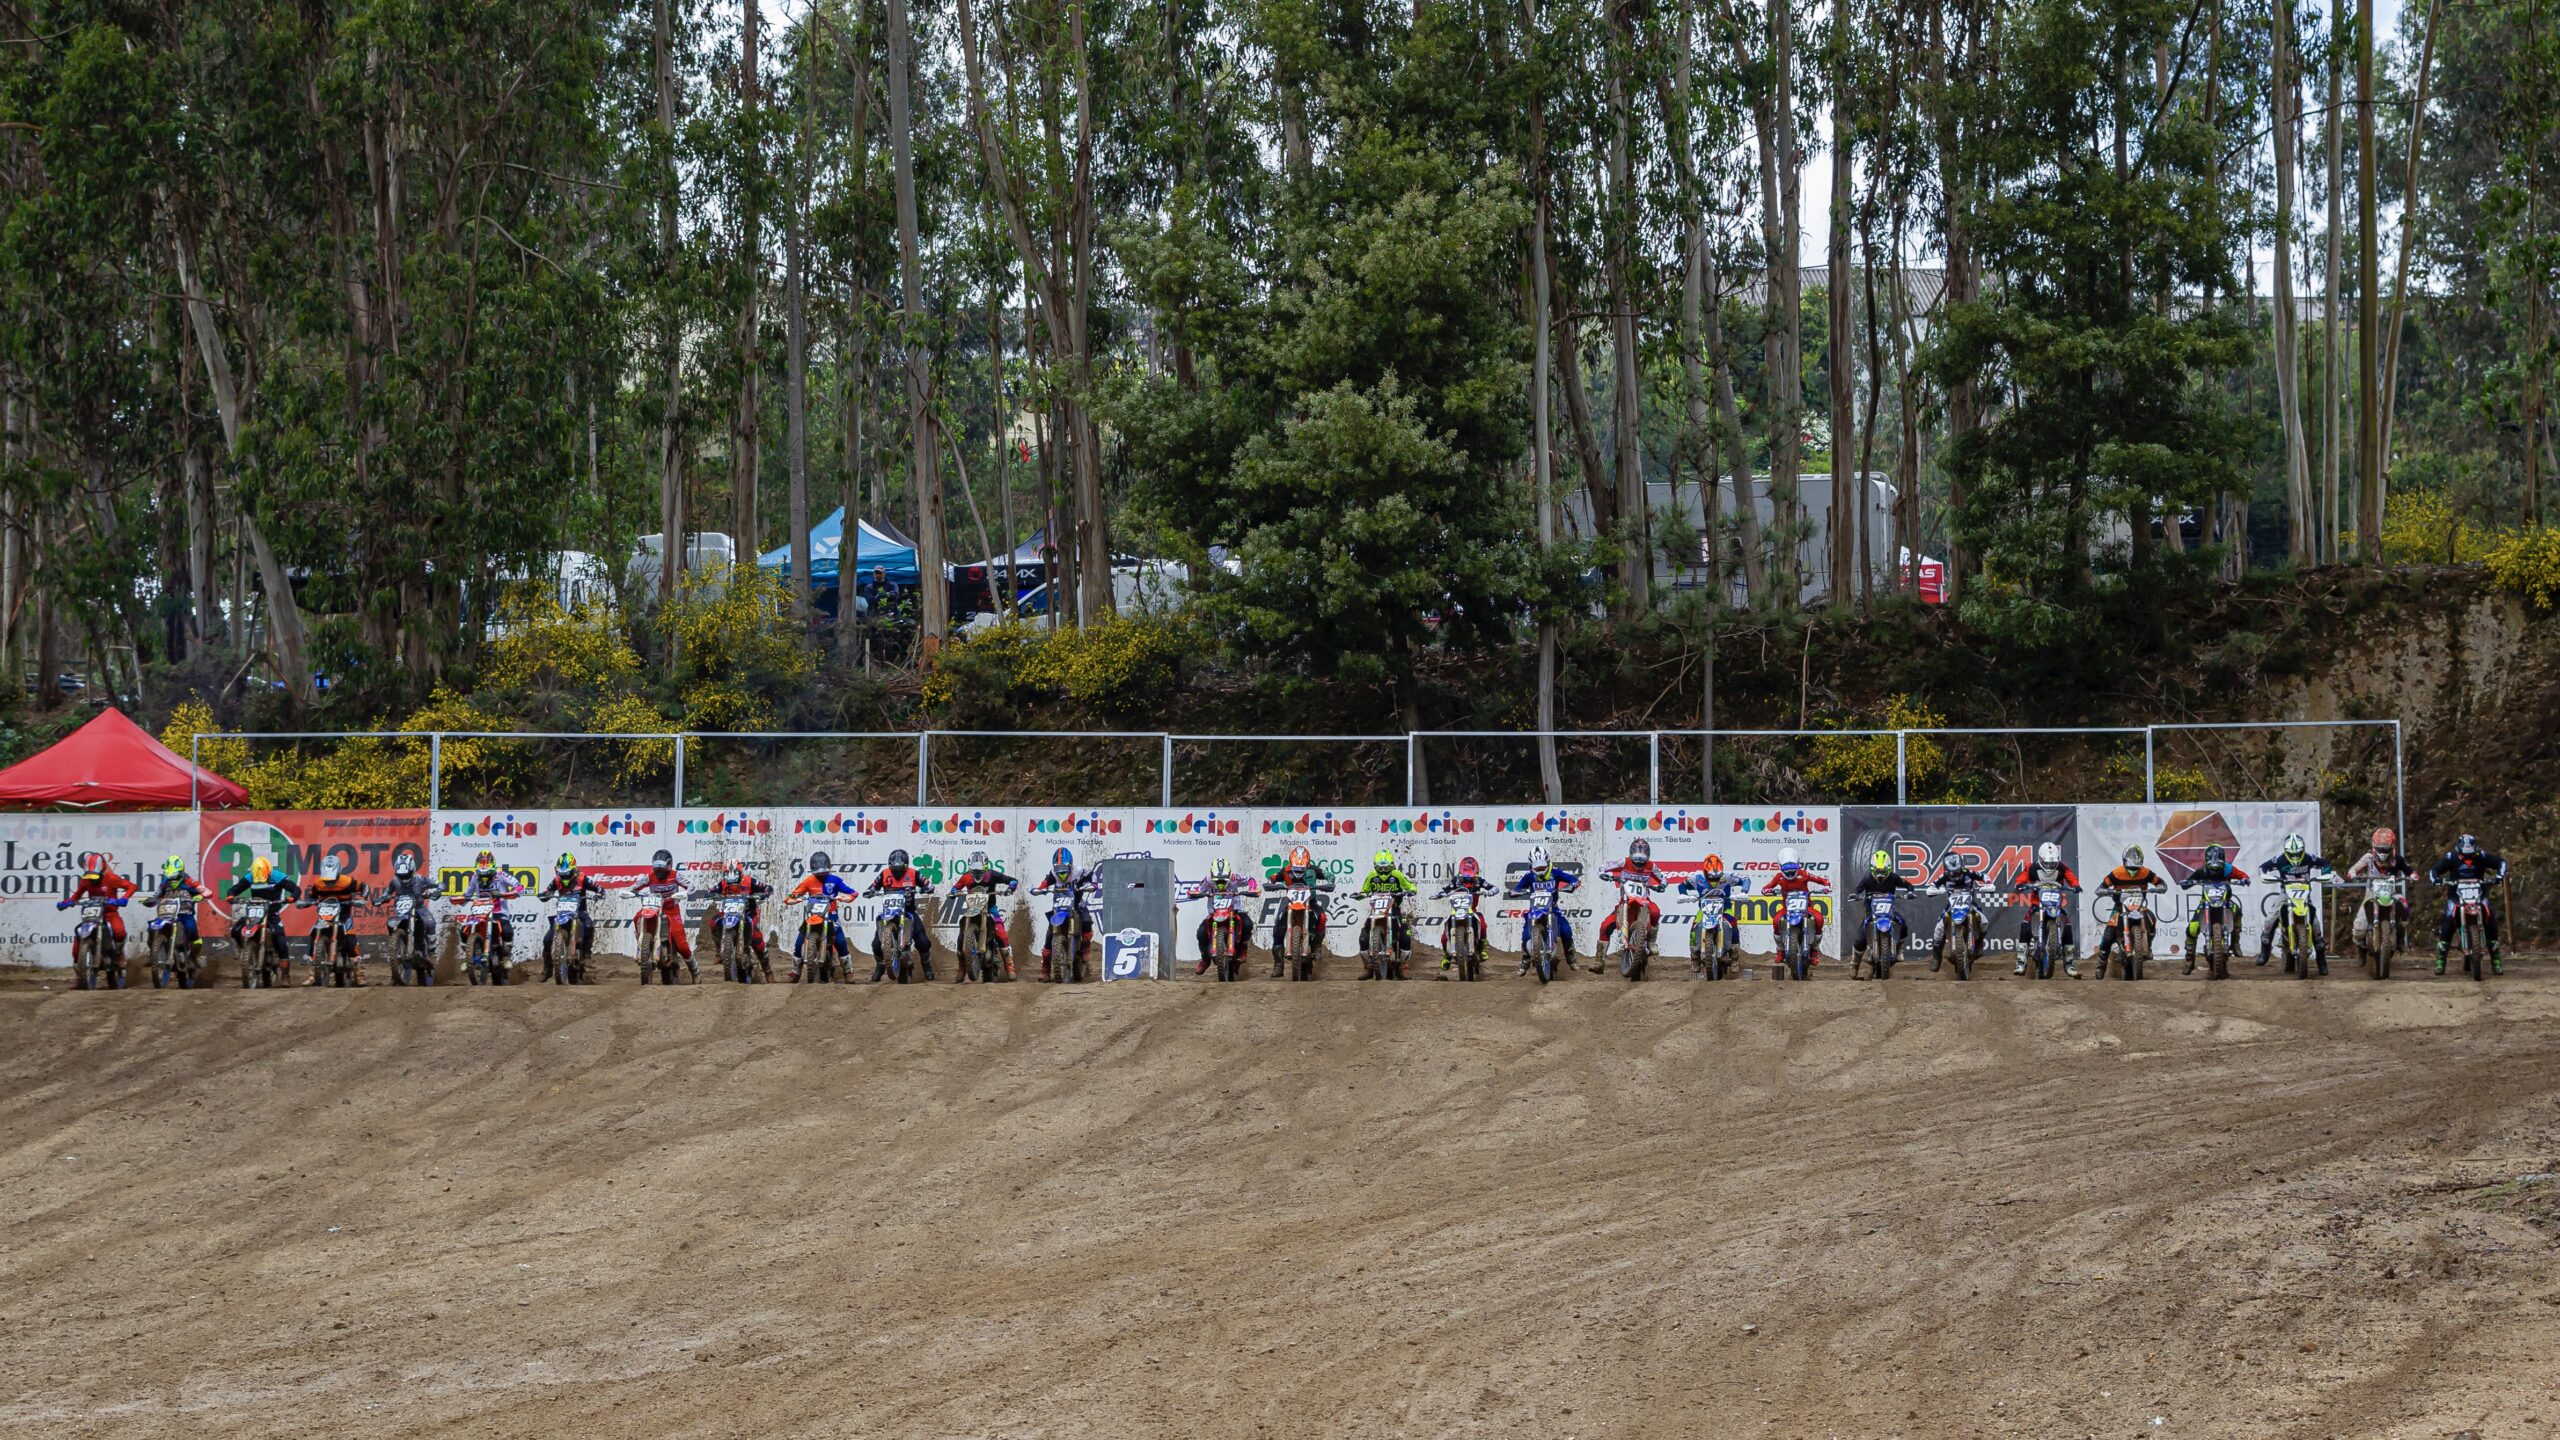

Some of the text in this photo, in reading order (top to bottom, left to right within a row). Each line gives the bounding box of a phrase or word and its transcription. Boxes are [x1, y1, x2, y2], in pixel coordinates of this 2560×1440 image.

[286, 842, 424, 876] MOTO
[676, 861, 770, 871] CROSPRO
[808, 863, 888, 873] COTT
[949, 859, 1005, 880] JOS
[1733, 861, 1830, 871] CROSPRO
[1291, 890, 1306, 902] 31
[2291, 888, 2306, 897] 77
[1453, 899, 1470, 908] 32
[1788, 898, 1807, 911] 20
